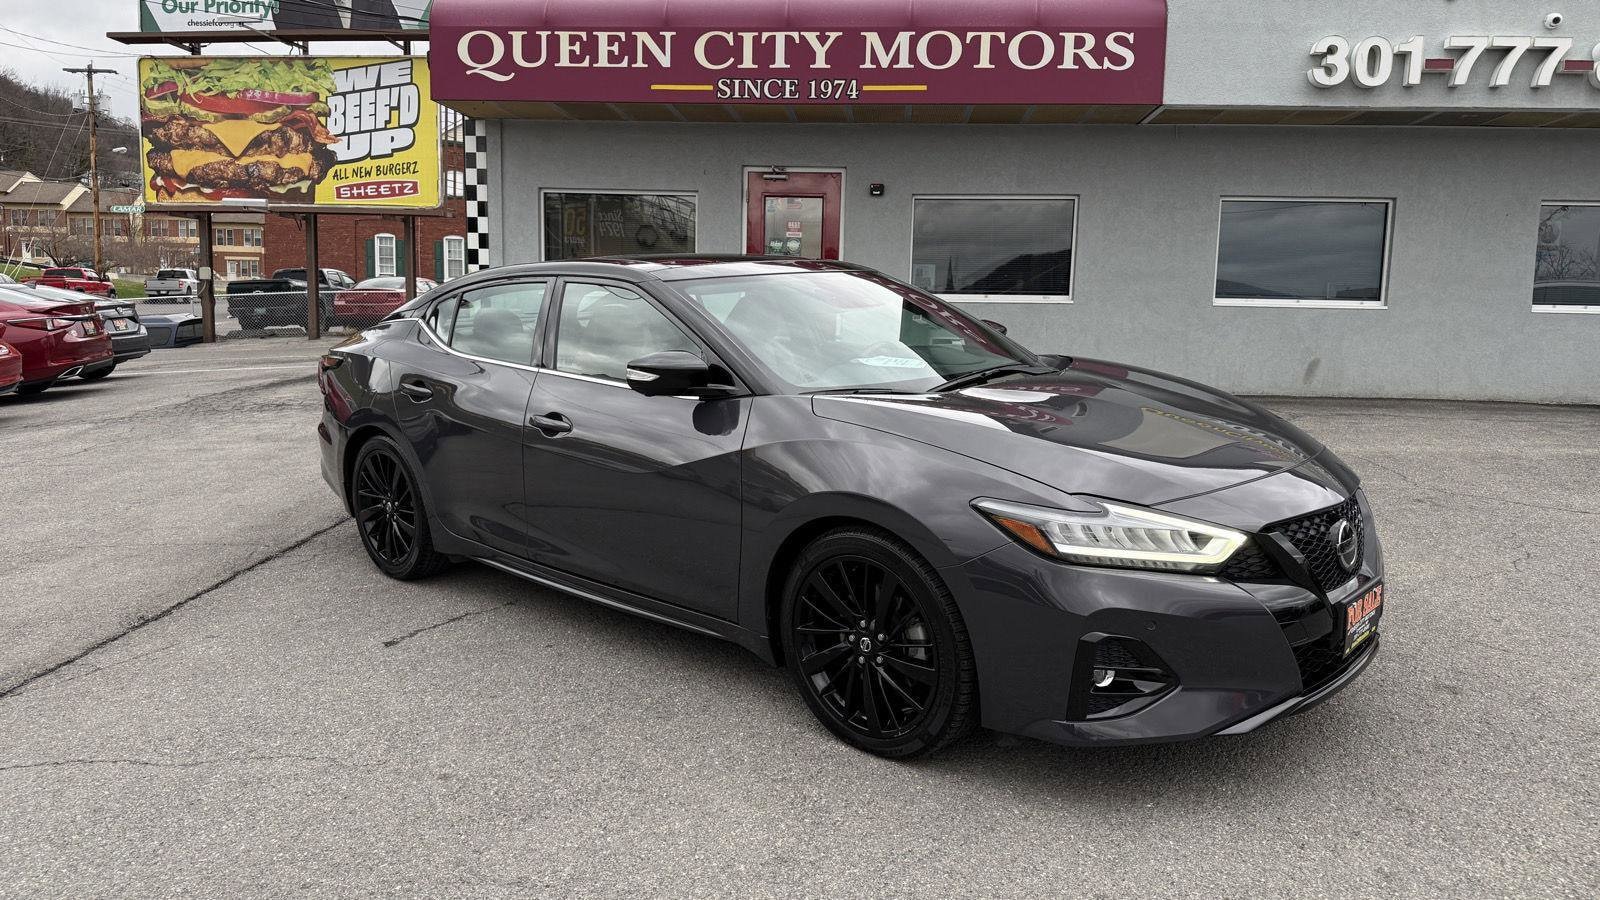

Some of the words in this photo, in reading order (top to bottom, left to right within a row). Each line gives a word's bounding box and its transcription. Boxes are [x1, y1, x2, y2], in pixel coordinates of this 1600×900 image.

[162, 0, 198, 14] Our
[457, 30, 676, 82] QUEEN
[694, 30, 843, 70] CITY
[859, 30, 1135, 71] MOTORS
[1307, 34, 1600, 89] 301-777-
[333, 59, 412, 95] WE
[716, 77, 800, 99] SINCE
[807, 79, 860, 99] 1974
[327, 84, 420, 136] BEEF'D
[328, 128, 415, 164] UP
[333, 171, 349, 181] ALL
[352, 165, 373, 178] NEW
[376, 161, 419, 177] BURGERZ
[340, 183, 414, 198] SHEETZ
[112, 205, 144, 213] LAMAR
